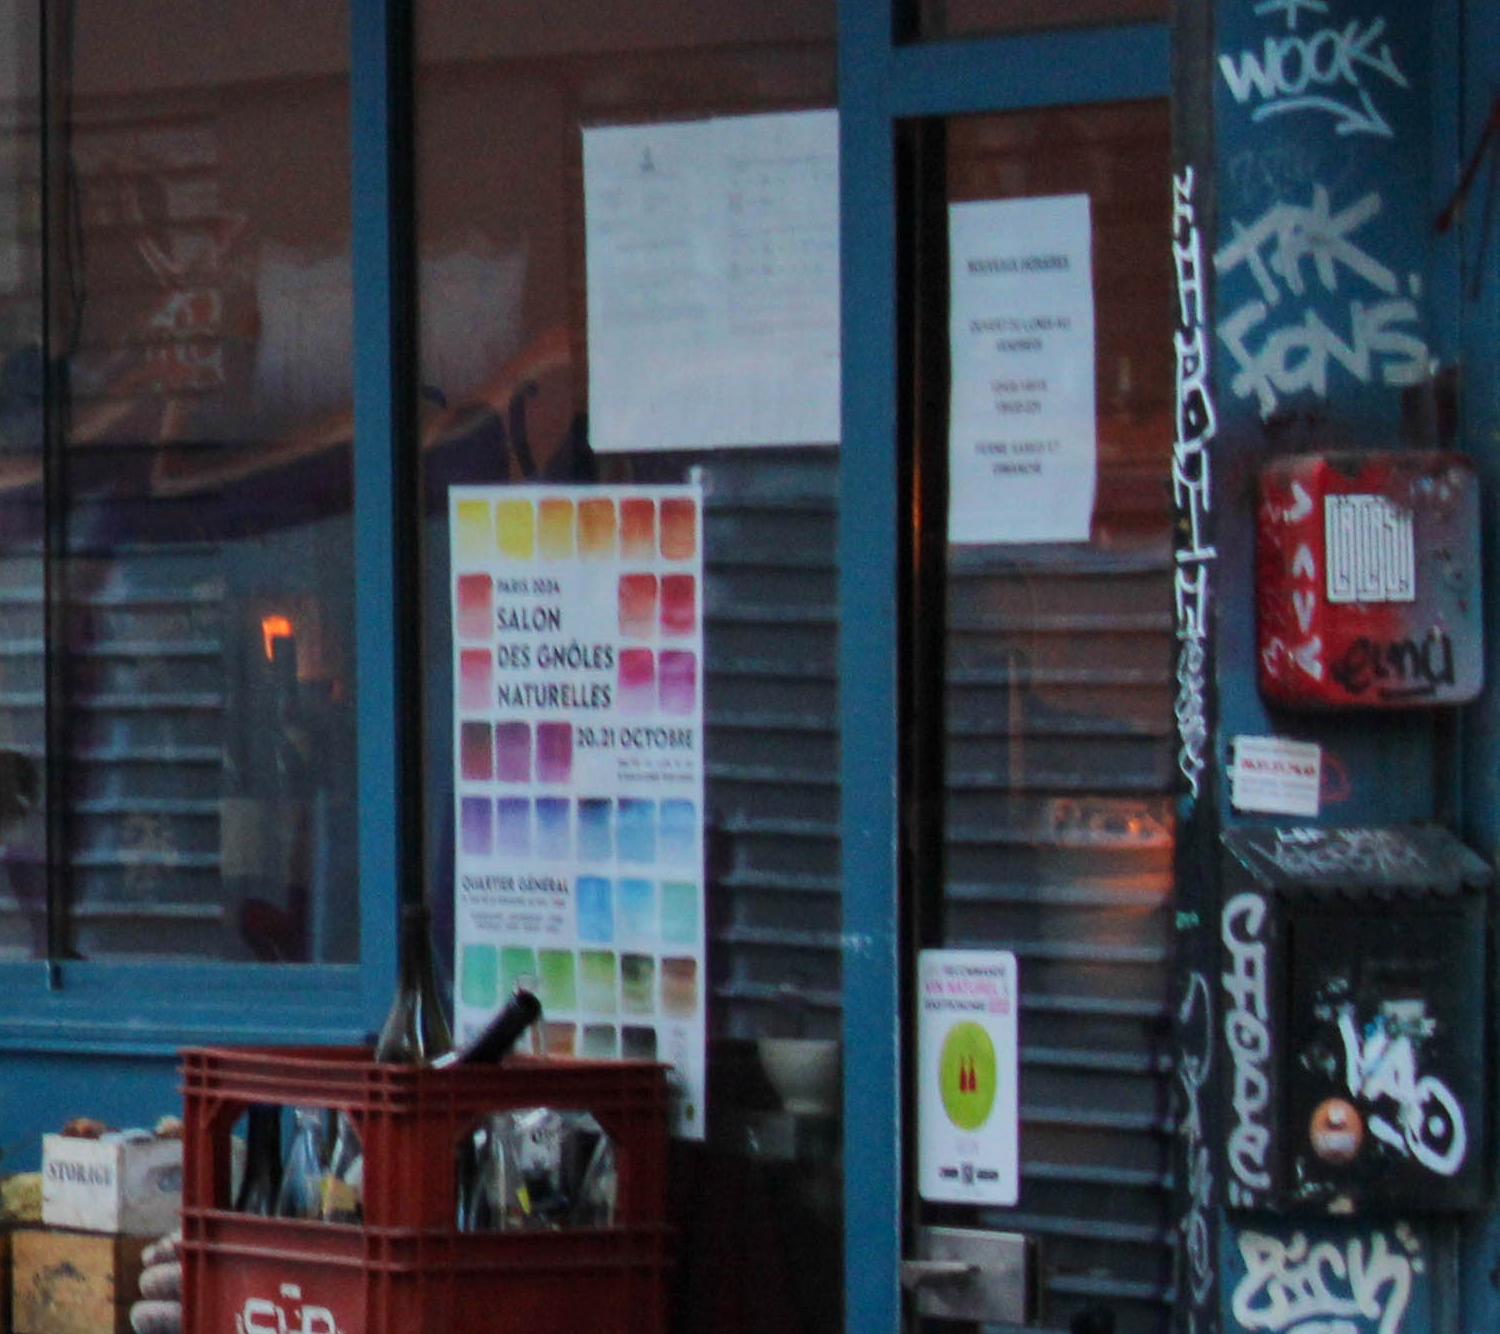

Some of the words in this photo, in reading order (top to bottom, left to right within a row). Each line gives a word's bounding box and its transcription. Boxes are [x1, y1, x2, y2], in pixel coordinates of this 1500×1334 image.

[496, 607, 561, 632] SALON
[498, 643, 531, 669] DES
[536, 638, 614, 670] GNÔLES
[498, 682, 612, 710] NATURELLES
[619, 727, 694, 749] OCTOBRE
